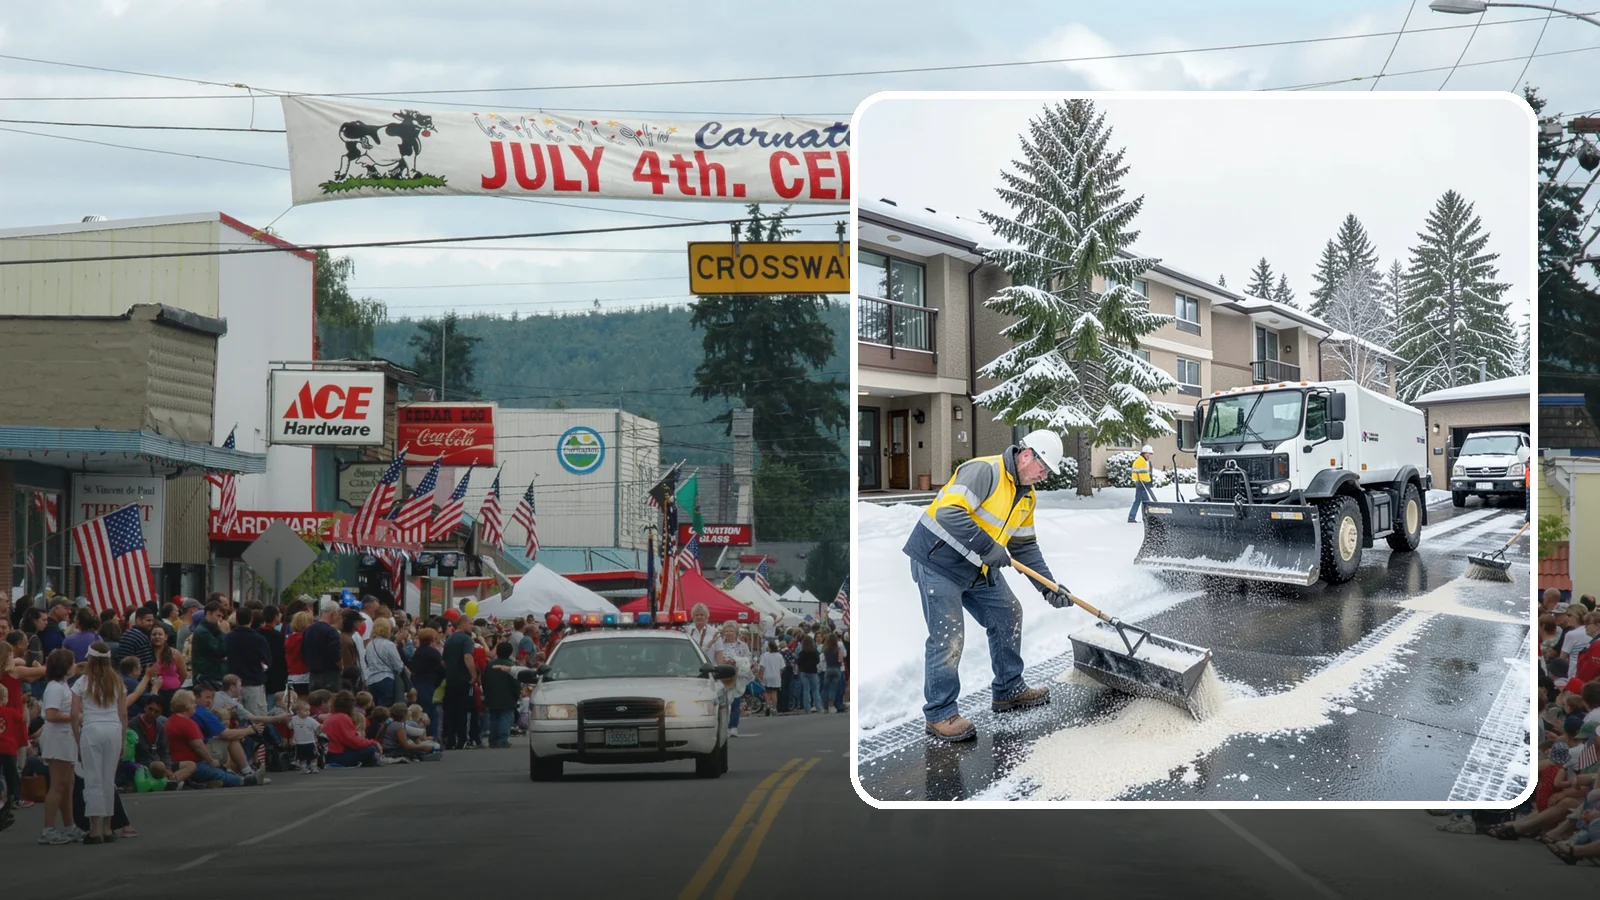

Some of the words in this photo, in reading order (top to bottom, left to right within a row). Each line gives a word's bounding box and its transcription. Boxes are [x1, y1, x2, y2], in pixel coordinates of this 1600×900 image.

[481, 141, 604, 192] JULY
[632, 150, 747, 197] 4th.
[697, 254, 850, 279] CROSSWA
[283, 380, 373, 419] ACE
[406, 409, 452, 422] CEDAR
[283, 421, 371, 436] Hardware
[416, 428, 476, 446] Coca-Cola
[96, 485, 124, 494] Vincent
[126, 486, 135, 494] de
[137, 486, 155, 495] Paul
[688, 526, 742, 535] CRNATION
[699, 535, 730, 543] GLASS
